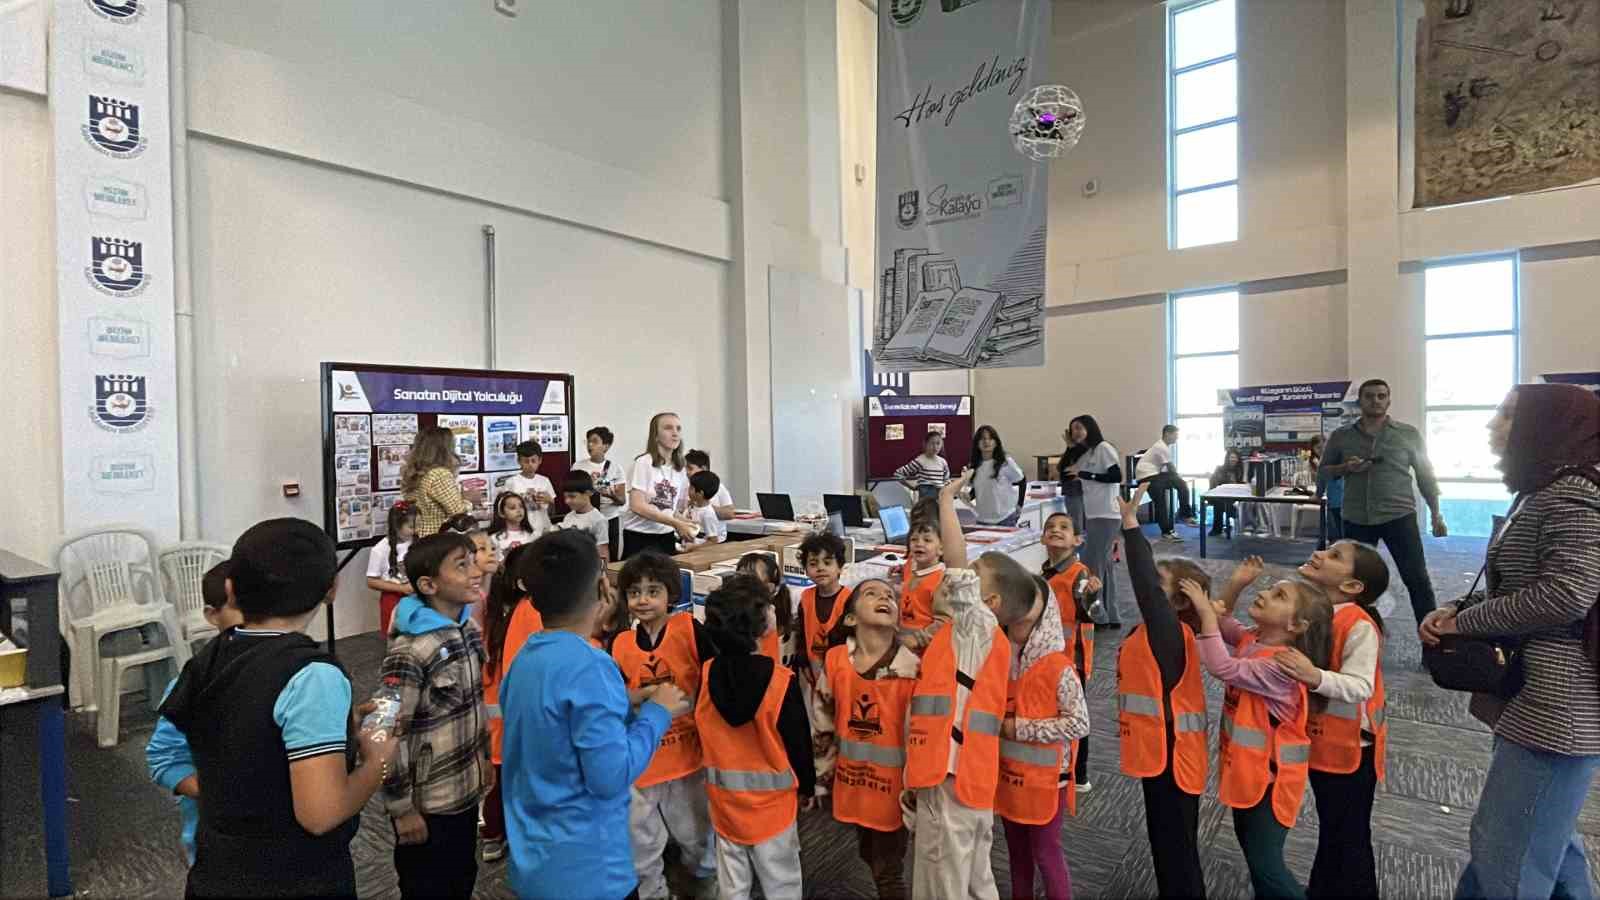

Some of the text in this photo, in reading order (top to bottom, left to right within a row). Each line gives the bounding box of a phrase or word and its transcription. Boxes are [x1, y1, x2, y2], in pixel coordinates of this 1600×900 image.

[393, 388, 523, 405] Sanatın Dijital Yolculuğu
